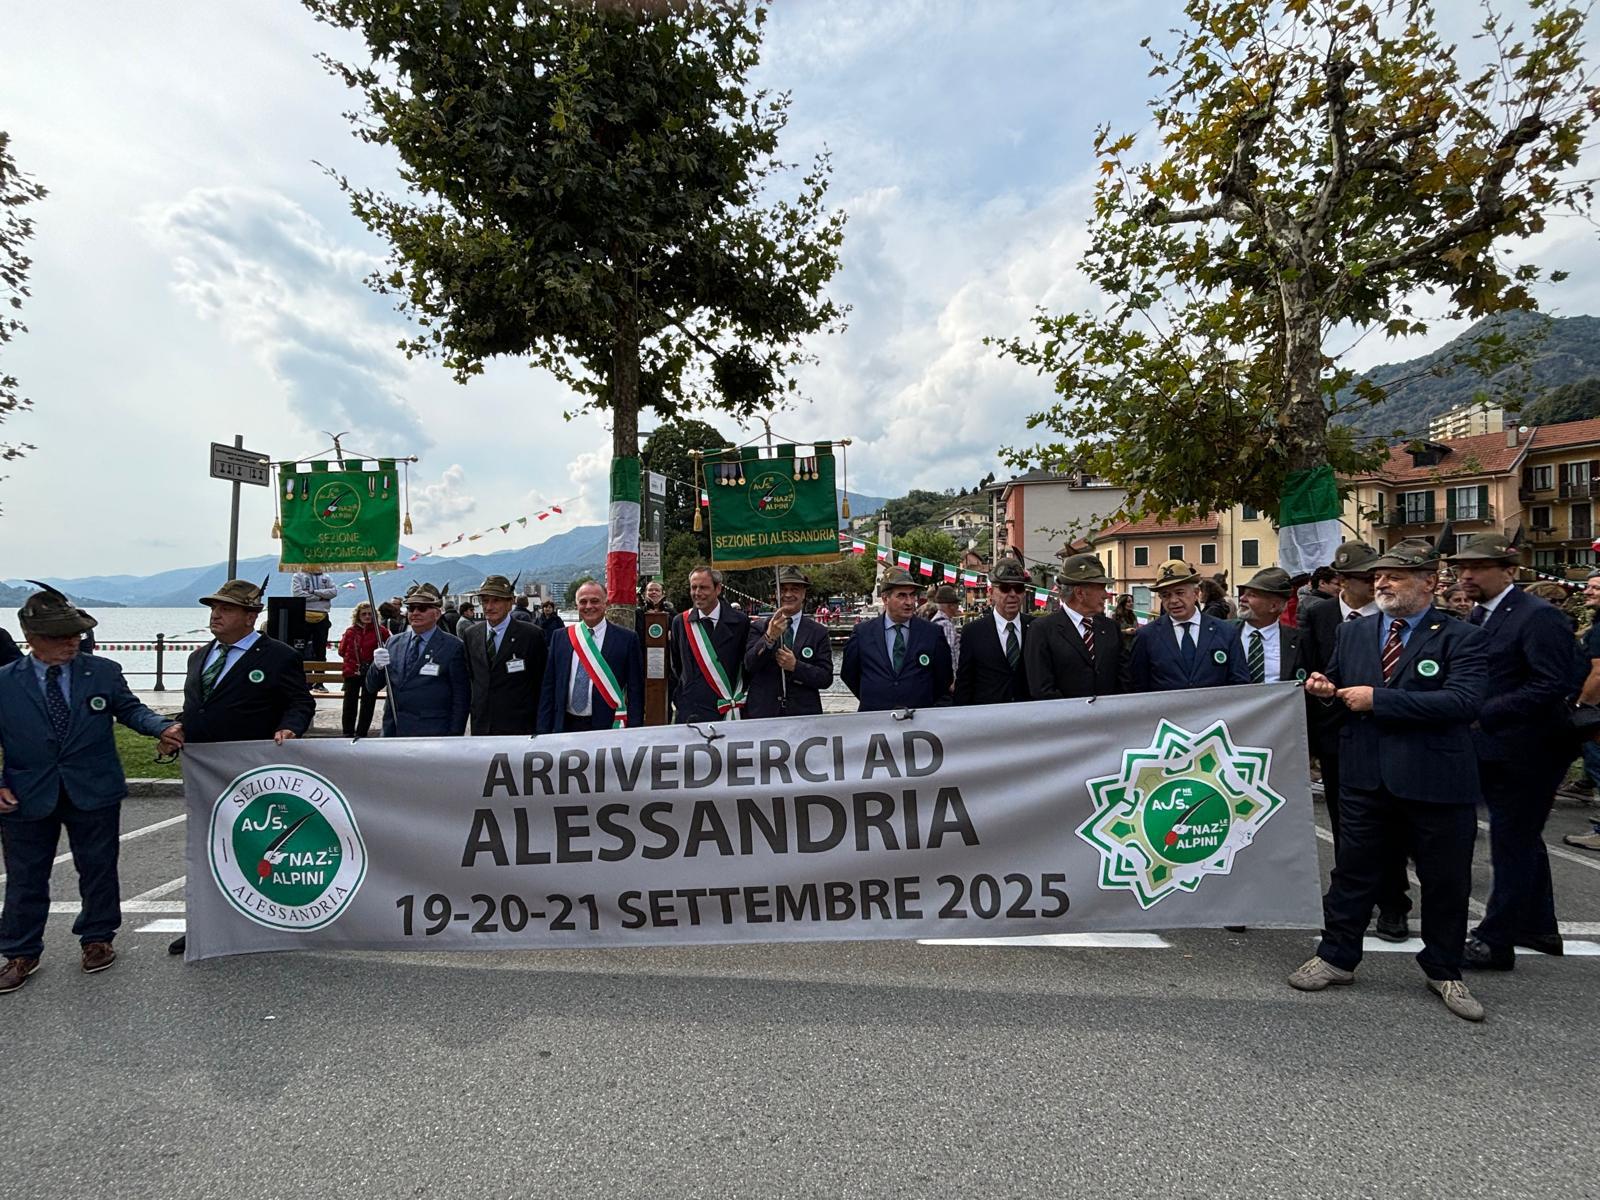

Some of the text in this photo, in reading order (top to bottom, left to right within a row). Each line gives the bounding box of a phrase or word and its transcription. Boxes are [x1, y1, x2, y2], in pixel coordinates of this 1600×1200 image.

[318, 532, 360, 544] SEZIONE
[716, 528, 836, 549] SEZIONE DI ALESSANDRIA
[482, 730, 945, 798] ARRIVEDERCI AD
[233, 775, 331, 808] SEZIONE DI
[460, 786, 981, 868] ALESSANDRIA
[1176, 836, 1218, 850] ALPINI
[272, 871, 324, 885] ALPINI
[233, 885, 348, 922] ALESSANDRIA
[396, 872, 1070, 937] 19-20-21 SETTEMBRE 2025
